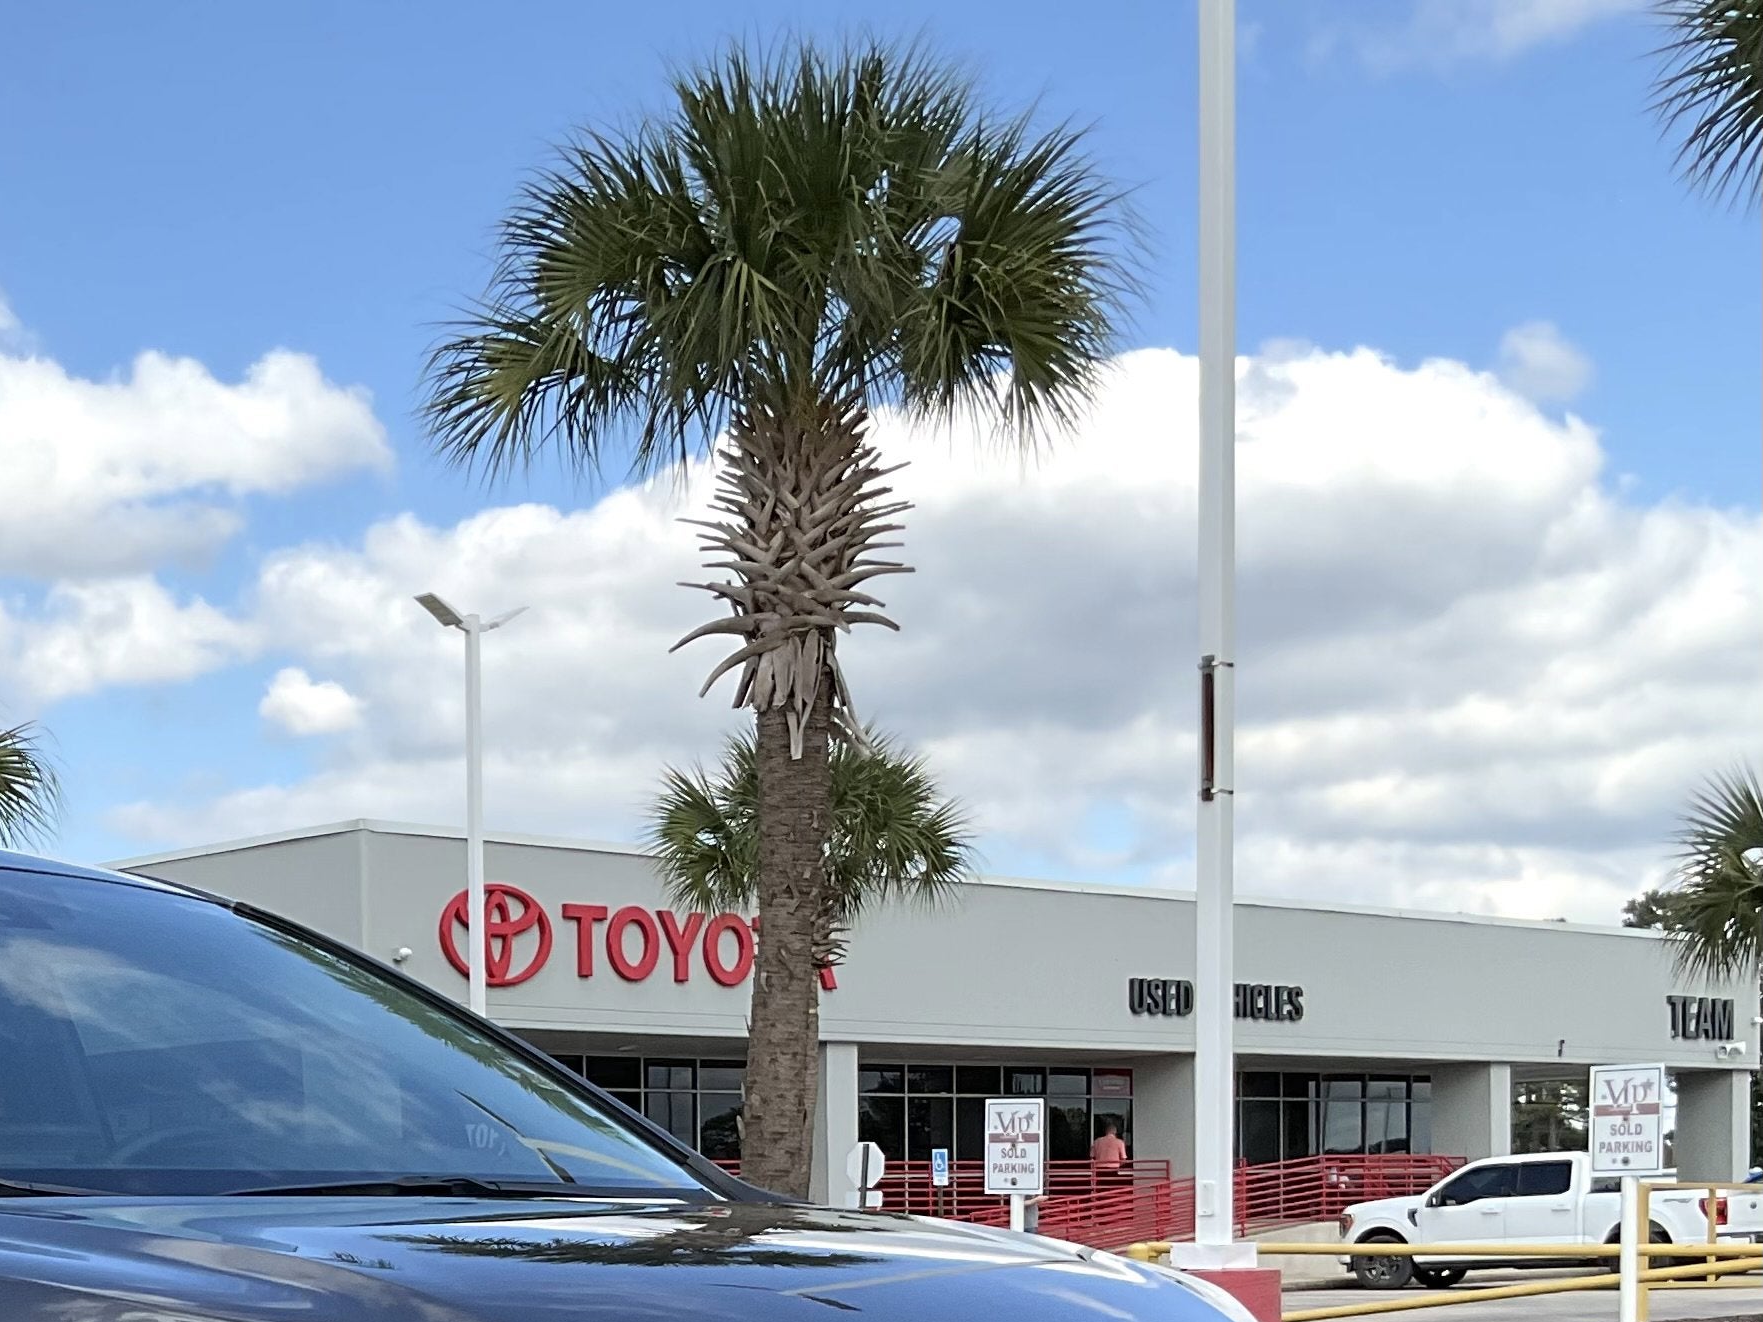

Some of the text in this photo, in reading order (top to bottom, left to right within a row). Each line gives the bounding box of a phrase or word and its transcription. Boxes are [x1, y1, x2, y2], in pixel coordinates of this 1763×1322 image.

[561, 903, 838, 991] TOYO
[1128, 977, 1305, 1021] USED HICLES
[1666, 995, 1735, 1041] TEAM
[1609, 1123, 1643, 1136] SOLD
[1000, 1147, 1027, 1159] SOLD
[1598, 1141, 1653, 1154] PARKING
[992, 1163, 1035, 1174] PARKING
